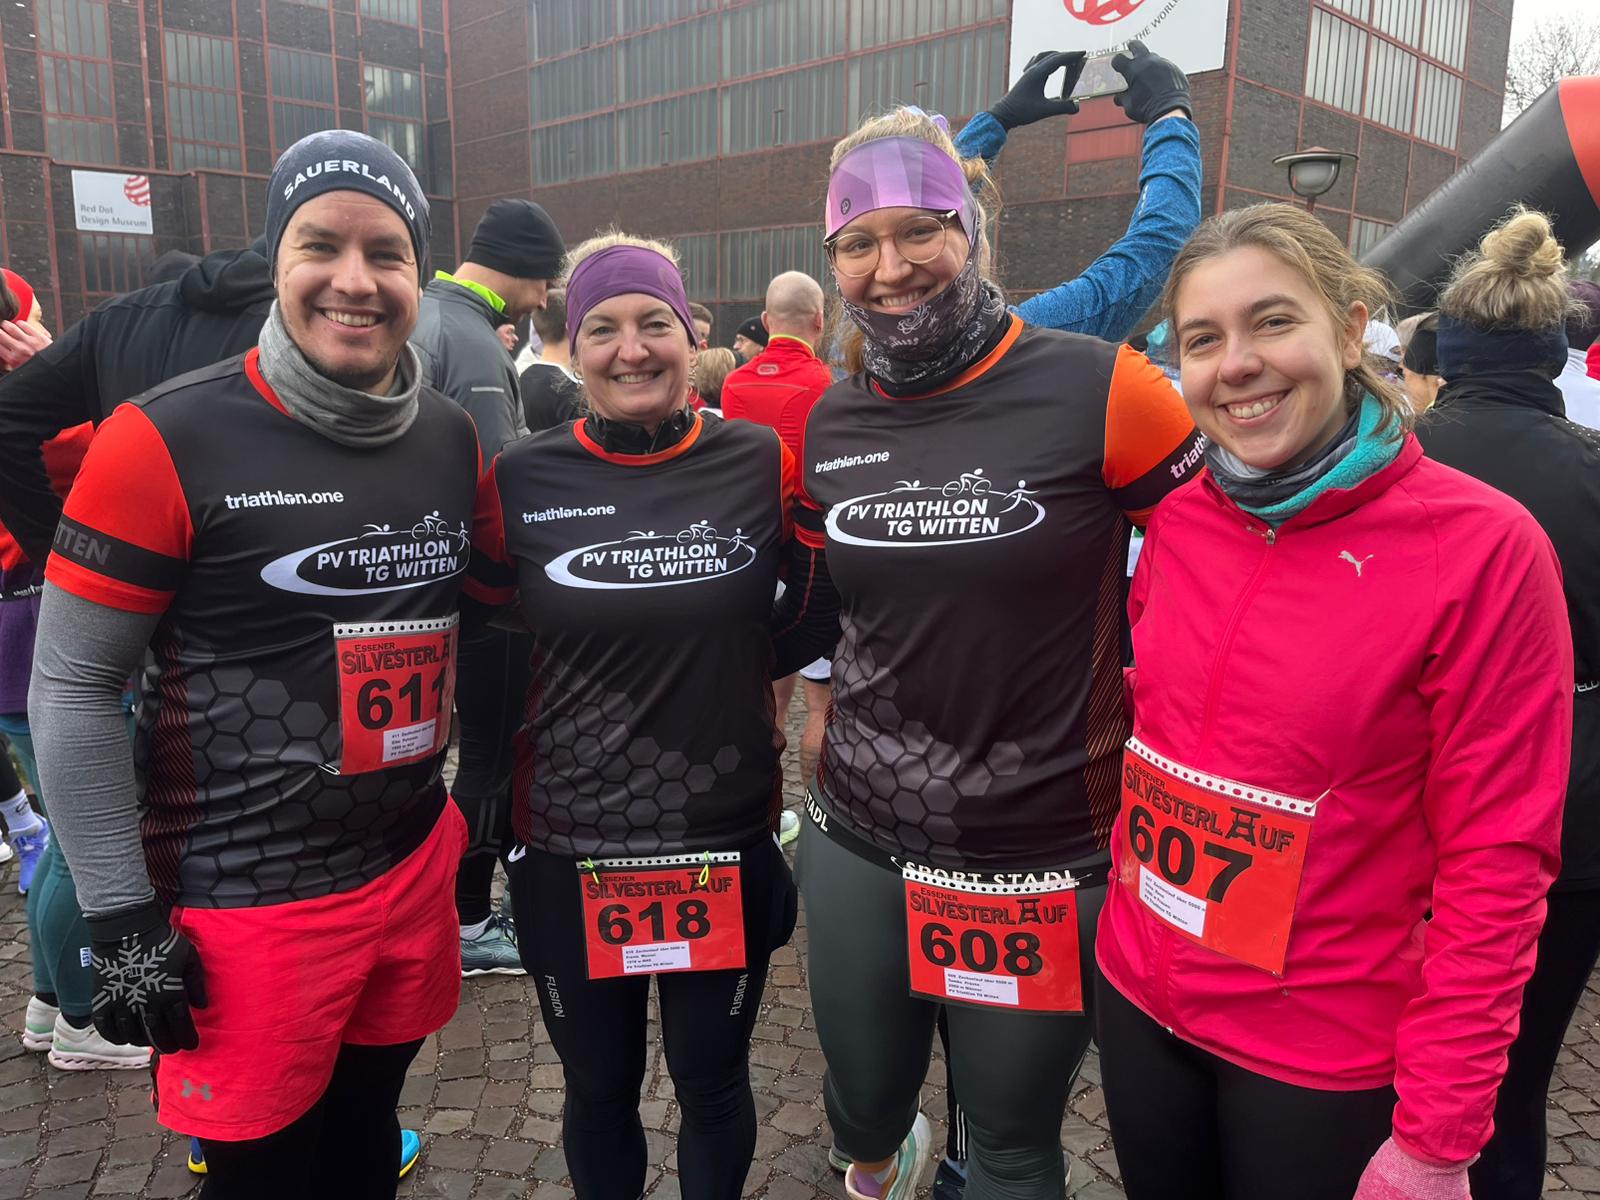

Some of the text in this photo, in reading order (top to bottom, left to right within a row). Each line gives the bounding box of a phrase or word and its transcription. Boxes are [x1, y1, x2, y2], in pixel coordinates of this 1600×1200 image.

[1134, 25, 1152, 41] THE
[1151, 0, 1180, 28] WORL
[284, 160, 415, 220] SAUERLAND
[80, 204, 113, 214] Red Dot
[81, 215, 147, 227] Design Museum
[815, 451, 890, 473] triathlon.one
[225, 490, 344, 510] triathlon.one
[847, 499, 989, 520] PV TRIATHLON
[522, 505, 616, 524] triathlon.one
[887, 517, 1000, 536] TG WITTEN
[317, 540, 450, 570] PV TRIATHLON
[582, 544, 717, 567] PV TRIATHLON
[365, 555, 458, 583] TG WITTEN
[628, 557, 728, 579] TG WITTEN
[1129, 804, 1253, 904] 607
[597, 899, 711, 945] 618
[920, 922, 1043, 977] 608
[544, 975, 565, 1018] FUSION
[730, 973, 749, 1017] FUSION
